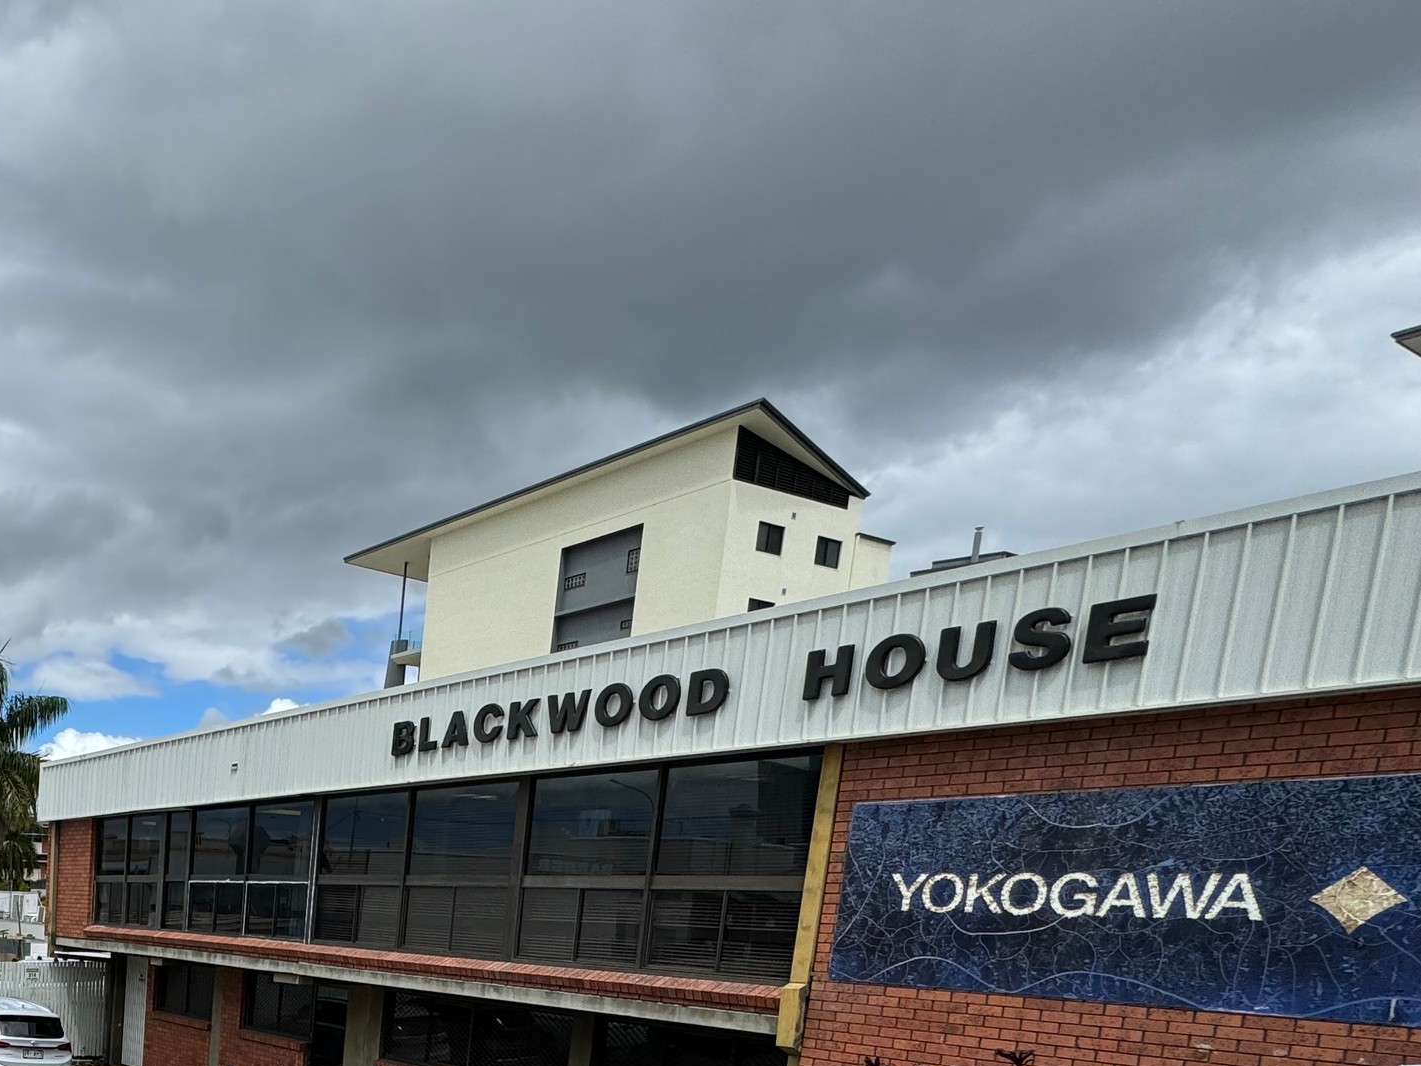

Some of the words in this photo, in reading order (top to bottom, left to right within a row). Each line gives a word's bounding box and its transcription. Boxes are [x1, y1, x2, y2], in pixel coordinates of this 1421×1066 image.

[391, 668, 730, 757] BLACKWOOD
[801, 594, 1158, 701] HOUSE
[891, 872, 1264, 922] YOKOGAWA
